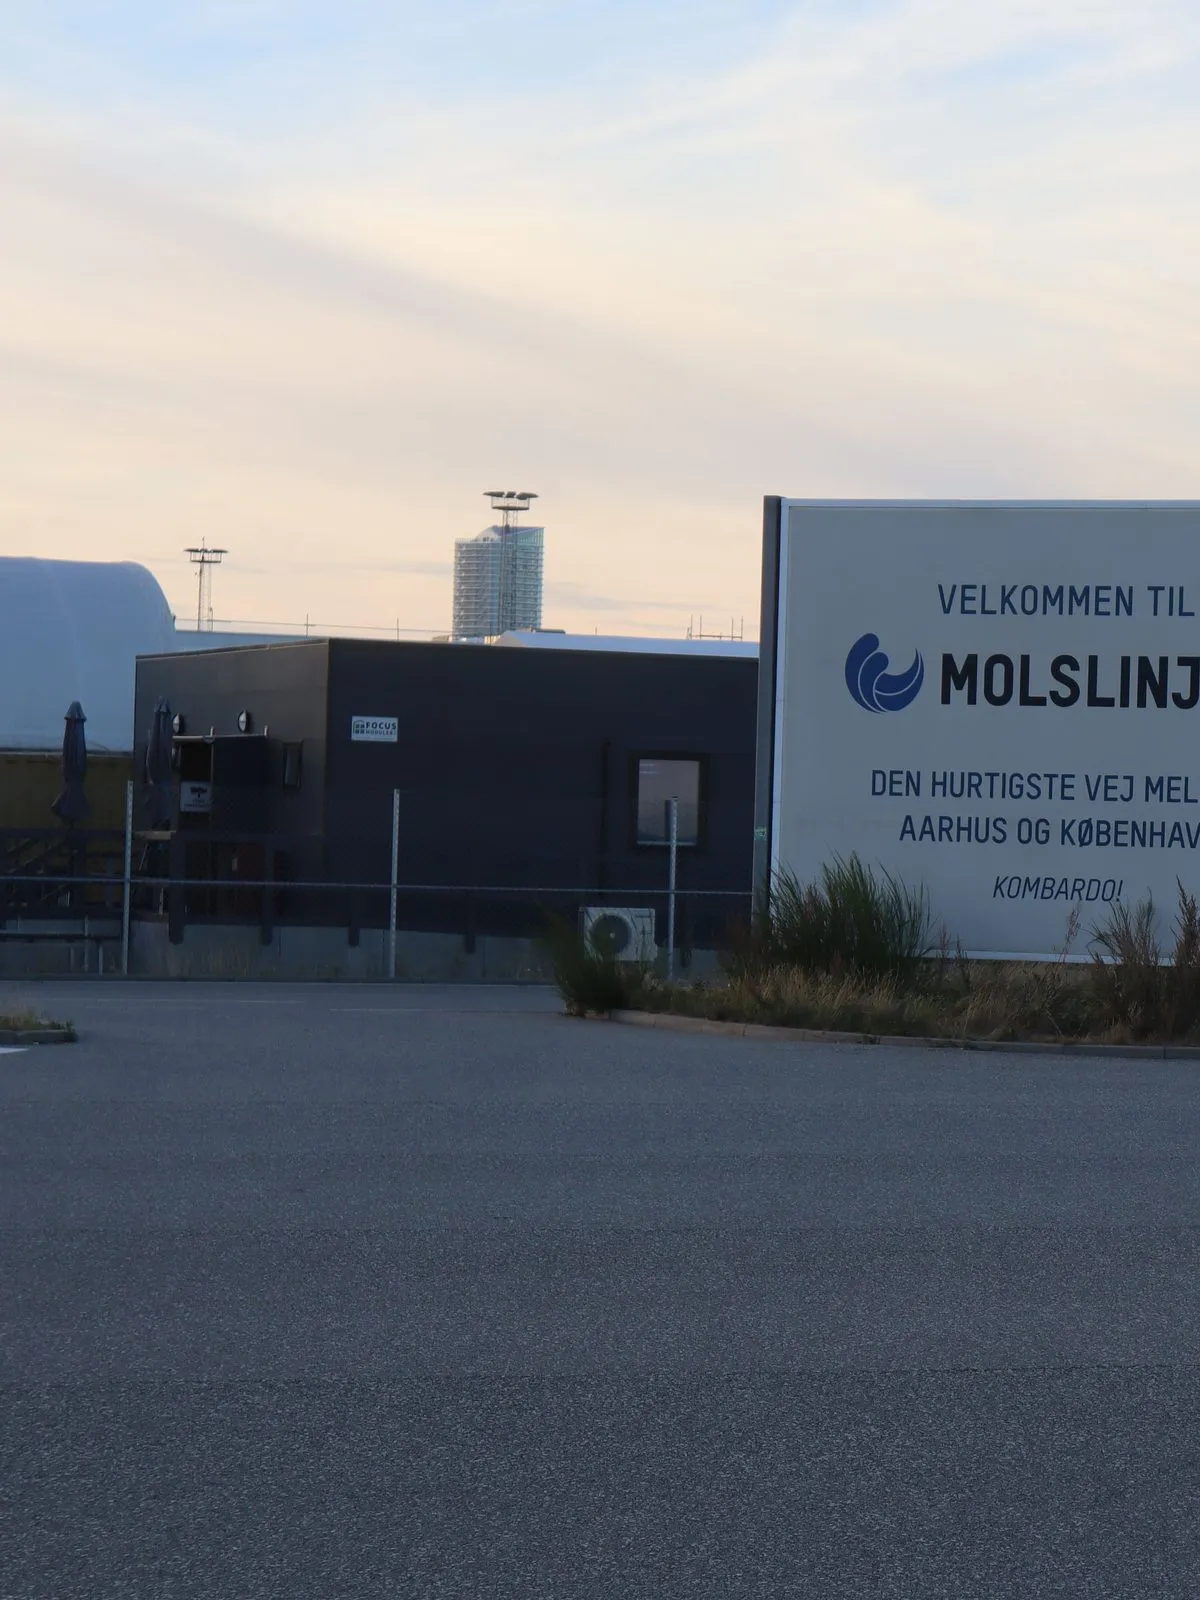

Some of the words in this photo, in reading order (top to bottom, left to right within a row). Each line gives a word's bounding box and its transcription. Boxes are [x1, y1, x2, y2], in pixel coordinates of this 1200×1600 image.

[938, 584, 1133, 616] VELKOMMEN
[1147, 585, 1195, 617] TIL
[366, 721, 397, 730] FOCUS
[871, 770, 921, 797] DEN
[931, 771, 1075, 801] HURTIGSTE
[1084, 774, 1133, 803] VEJ
[899, 815, 1007, 844] AARHUS
[1017, 817, 1050, 845] OG
[993, 876, 1123, 903] KOMBARDO!
